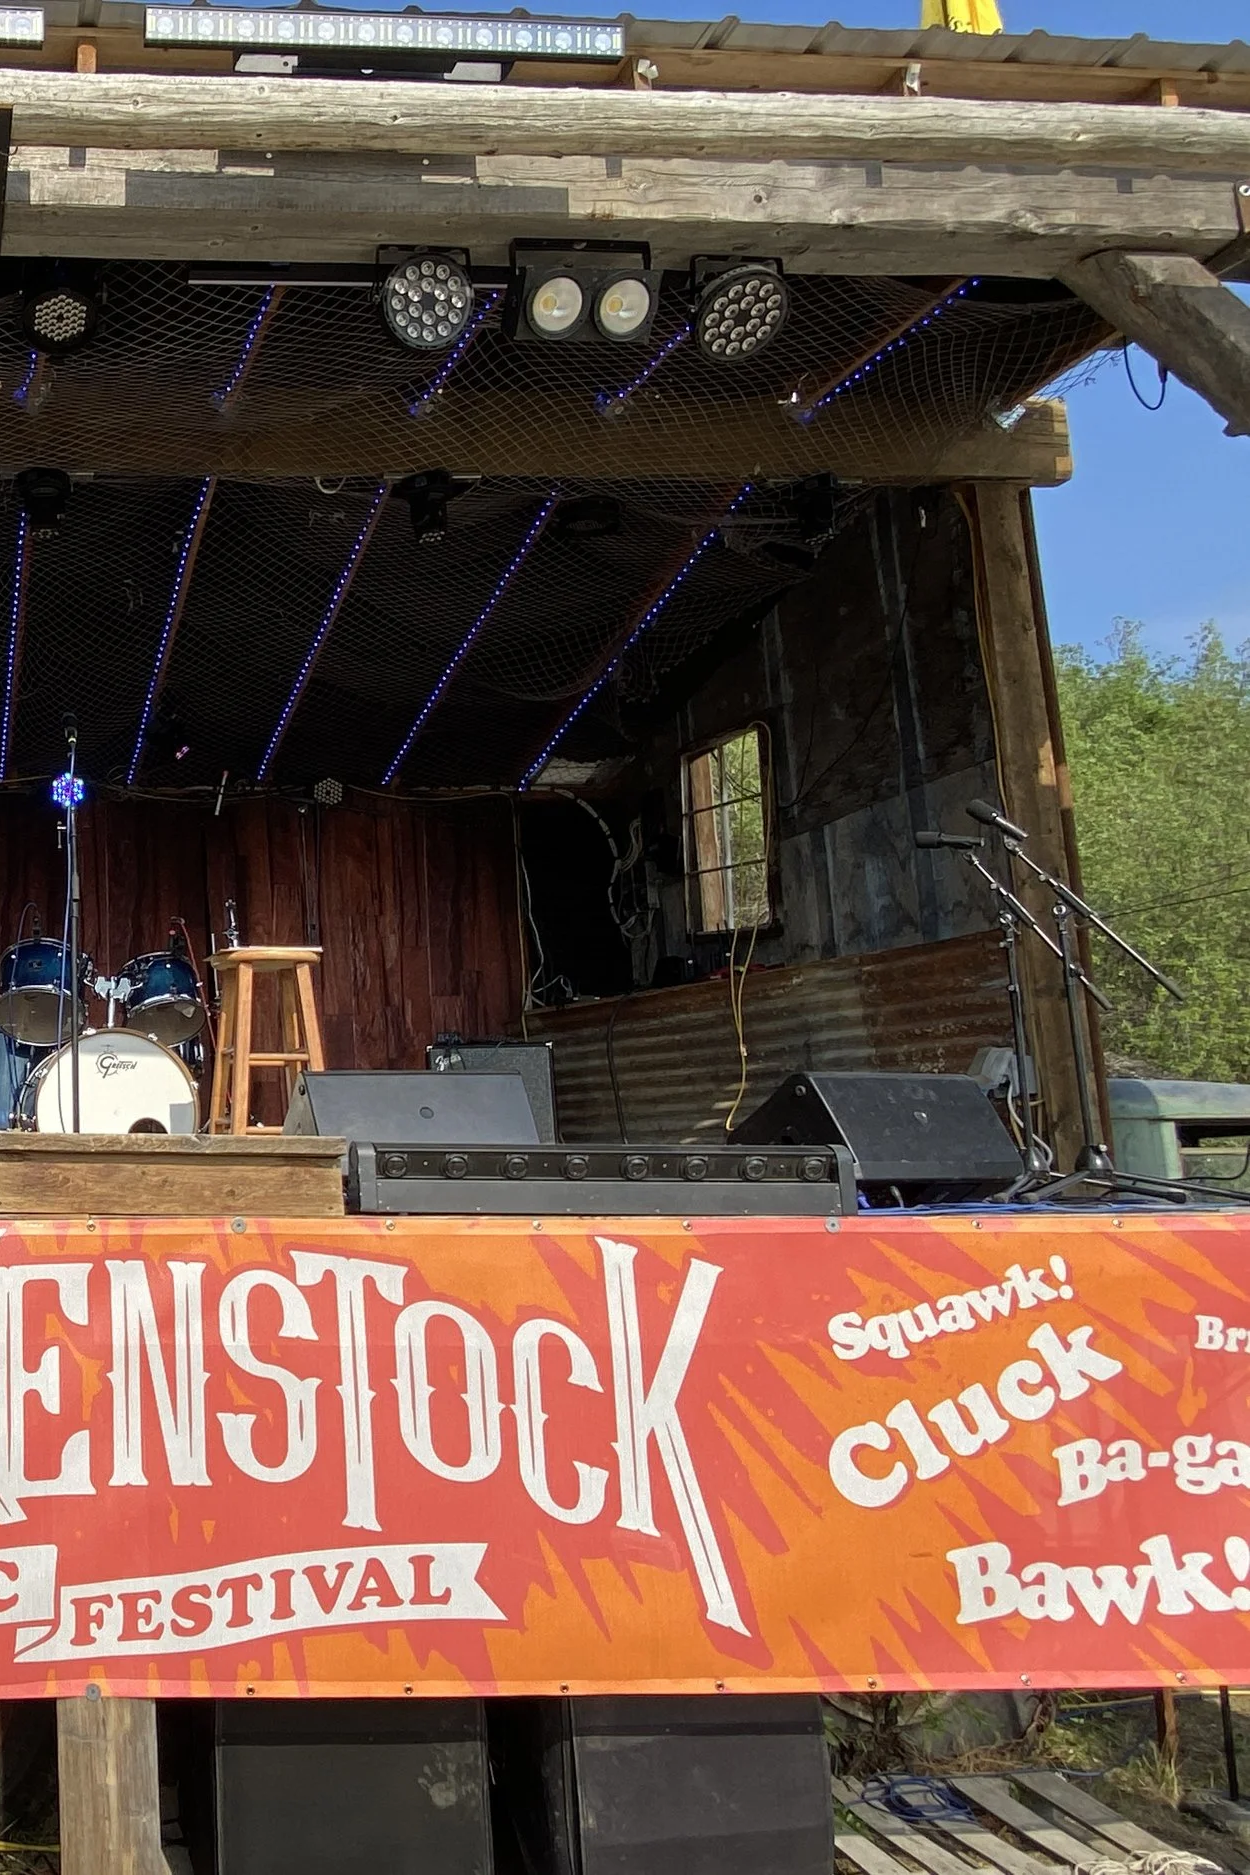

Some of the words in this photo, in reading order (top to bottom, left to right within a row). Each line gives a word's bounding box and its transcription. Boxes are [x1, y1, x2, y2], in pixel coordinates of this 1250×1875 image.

[828, 1254, 1074, 1360] Squawk!
[828, 1322, 1123, 1508] Cluck
[69, 1553, 452, 1648] FESTIVAL
[946, 1534, 1250, 1626] Bawk!
